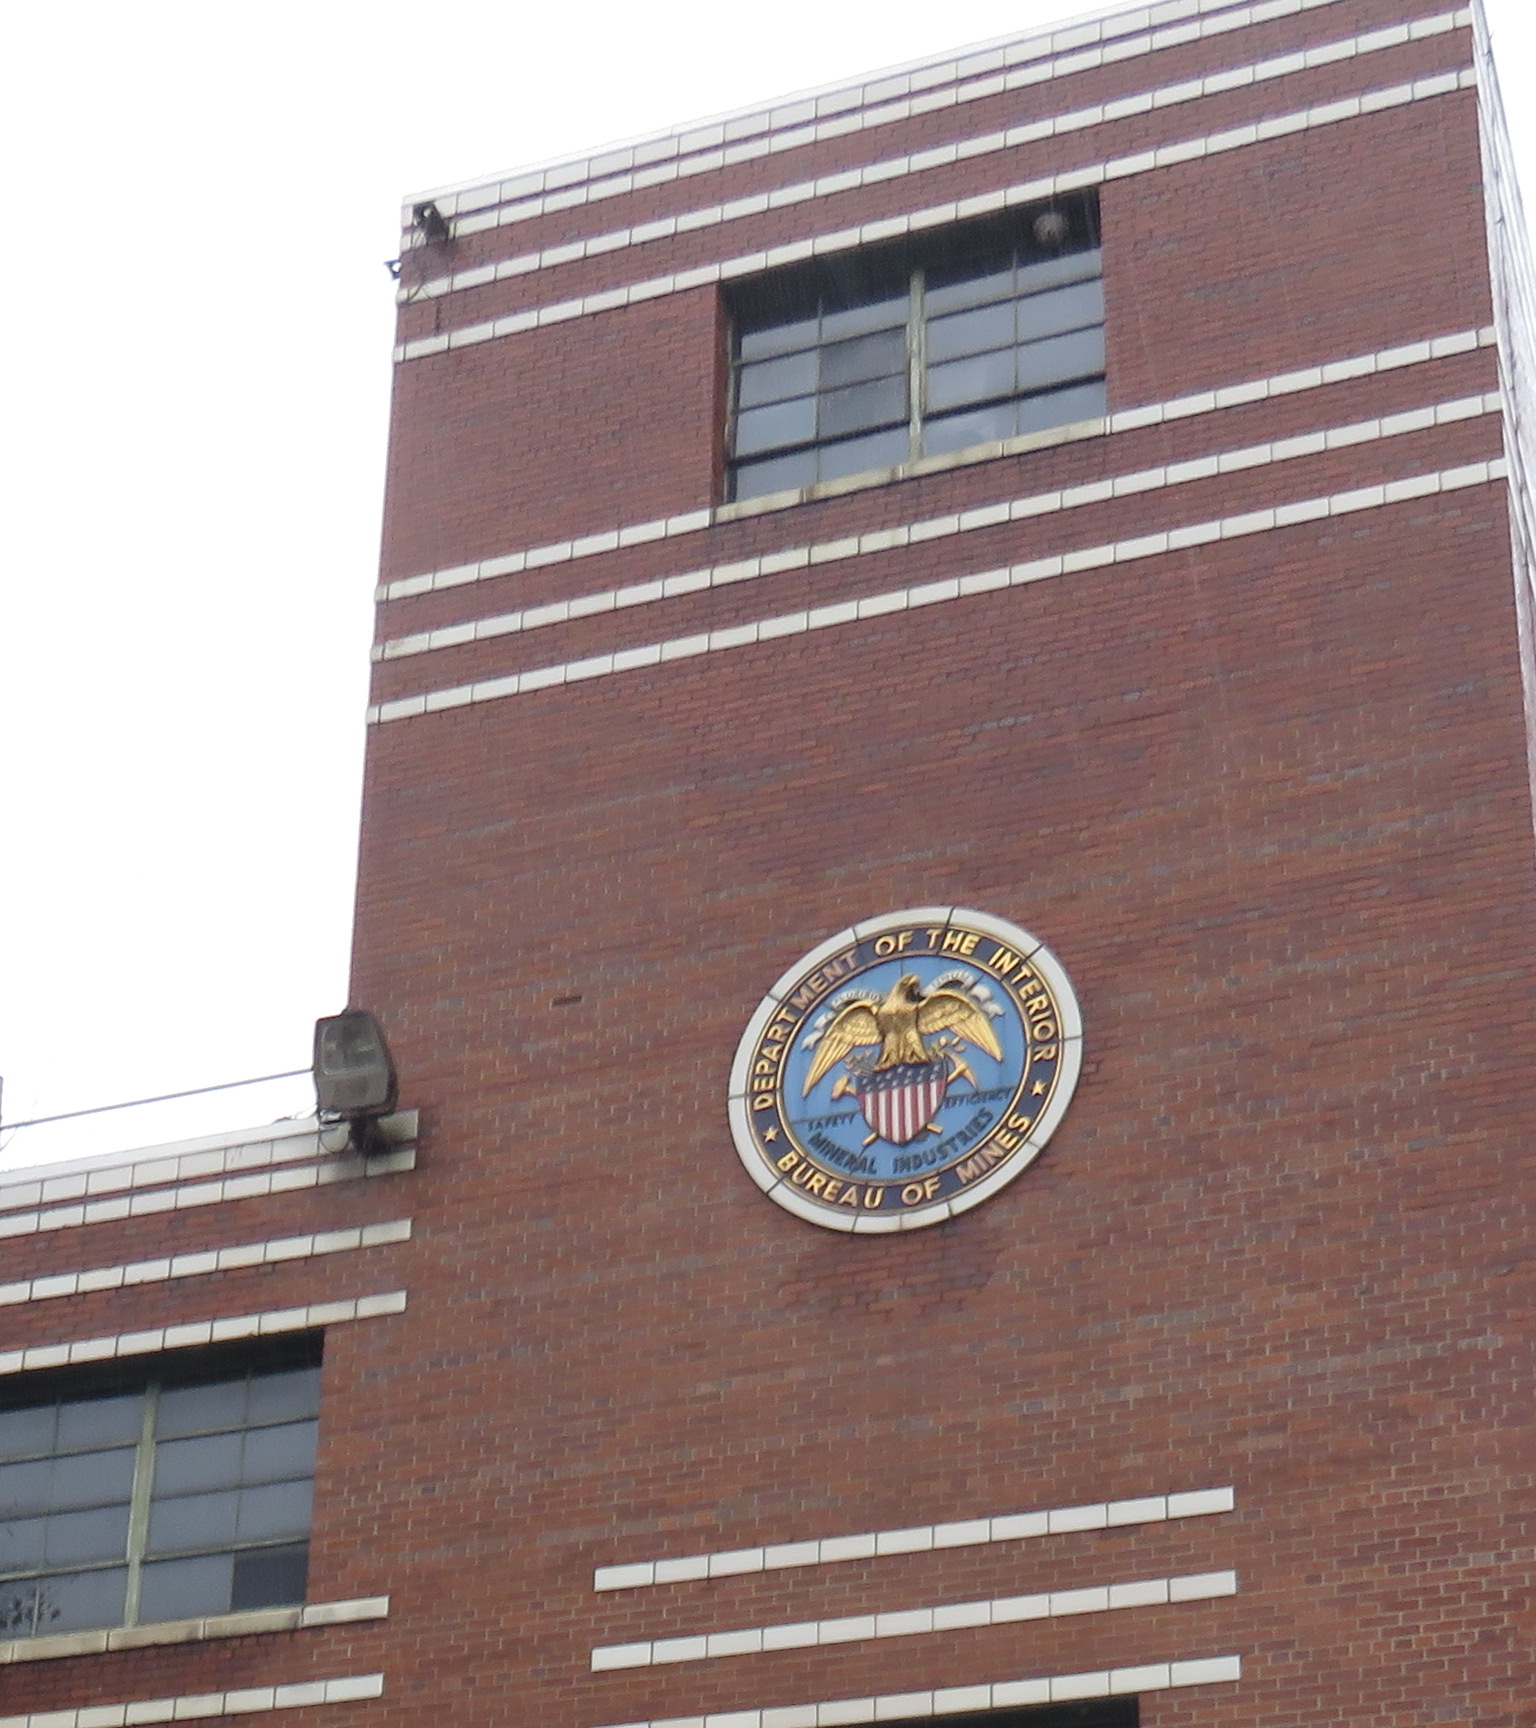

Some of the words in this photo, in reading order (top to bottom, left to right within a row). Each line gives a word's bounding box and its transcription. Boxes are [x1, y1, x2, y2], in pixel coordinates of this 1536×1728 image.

[753, 951, 859, 1112] DEPARTMENT
[874, 933, 913, 956] OF
[926, 928, 981, 956] THE
[988, 946, 1057, 1062] INTERIOR
[776, 1150, 885, 1210] BUREAU
[901, 1176, 941, 1206] OF
[955, 1112, 1030, 1186] MINES
[807, 1114, 856, 1132] SAFETY
[807, 1131, 878, 1175] MINERAL
[892, 1107, 994, 1174] INDUSTRIES
